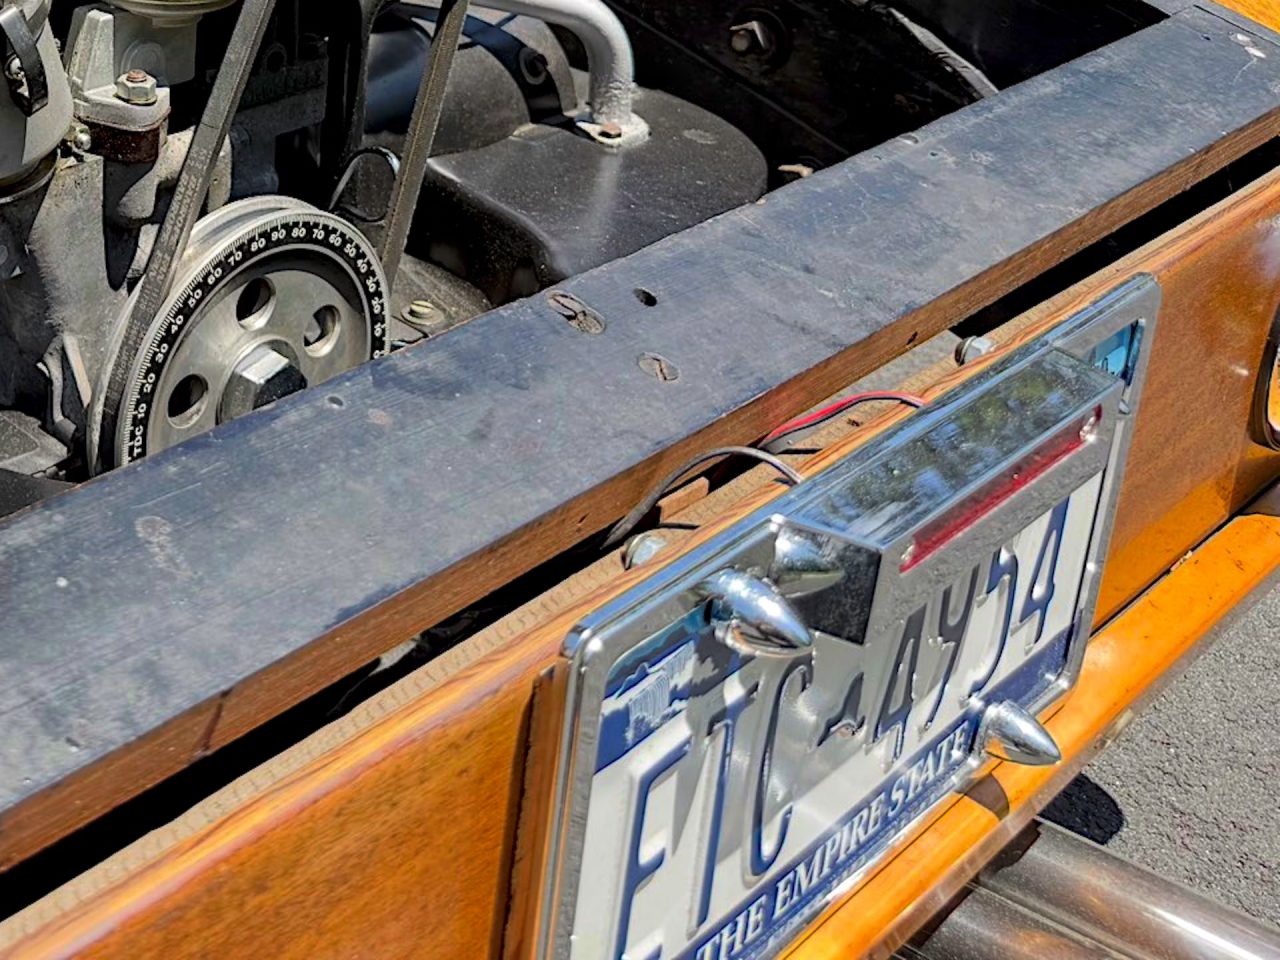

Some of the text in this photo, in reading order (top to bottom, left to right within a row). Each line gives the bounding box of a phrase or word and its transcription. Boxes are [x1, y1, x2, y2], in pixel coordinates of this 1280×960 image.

[271, 229, 286, 241] 90
[291, 227, 306, 238] 80
[312, 228, 325, 240] 70
[329, 233, 342, 247] 60
[250, 238, 266, 252] 80
[343, 243, 357, 257] 50
[227, 251, 242, 266] 70
[356, 258, 368, 273] 40
[207, 268, 222, 285] 60
[365, 276, 377, 293] 30
[188, 289, 202, 308] 50
[371, 296, 381, 314] 20
[170, 315, 184, 334] 40
[374, 322, 383, 337] 10
[155, 343, 169, 363] 30
[143, 373, 156, 393] 20
[137, 403, 147, 419] 10
[132, 424, 144, 457] TDC
[772, 794, 887, 919] EMPIRE
[886, 721, 970, 817] STATE
